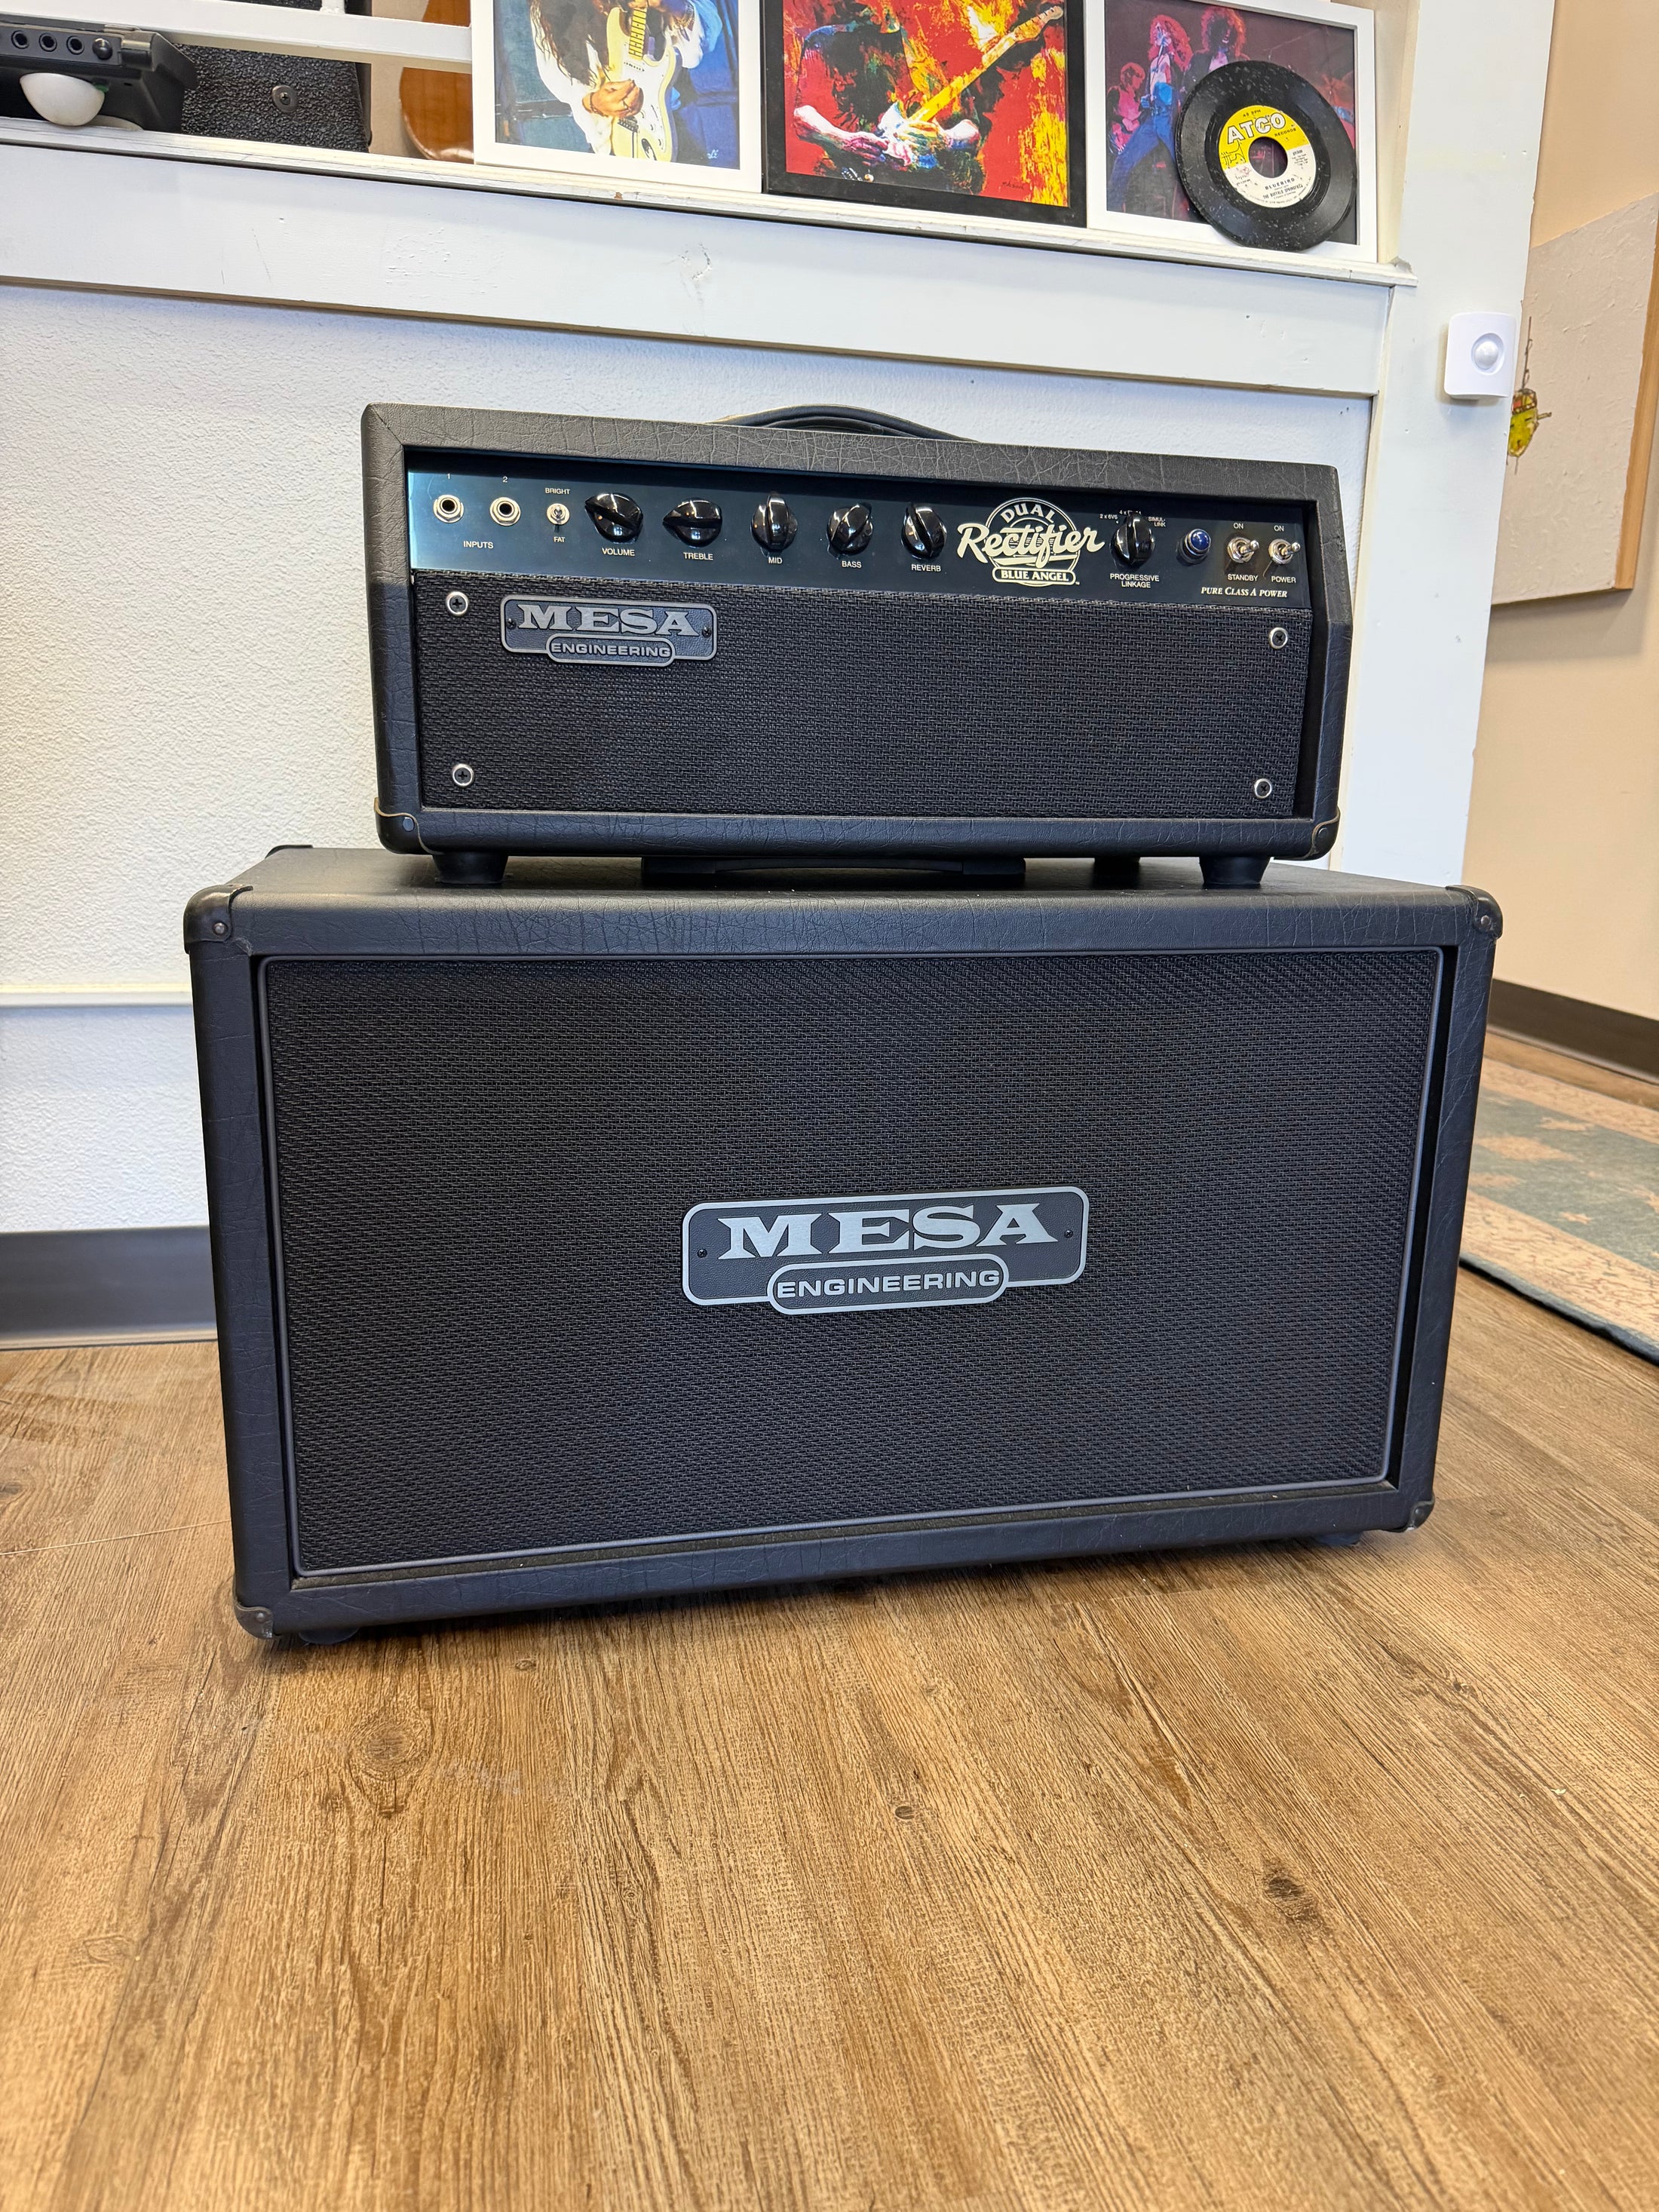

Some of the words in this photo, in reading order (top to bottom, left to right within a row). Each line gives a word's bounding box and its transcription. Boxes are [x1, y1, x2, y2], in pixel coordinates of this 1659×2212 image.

[1228, 112, 1286, 145] ATCO
[1274, 127, 1296, 137] RECORDS
[1265, 177, 1295, 190] BLUEBIRD
[1000, 503, 1056, 523] DUAL
[463, 541, 494, 549] INPUTS
[957, 523, 1105, 569] Rectifier
[602, 548, 635, 557] VOLUME
[682, 552, 713, 561] TREBLE
[768, 556, 783, 564] MID
[842, 560, 862, 569] BASS
[911, 563, 941, 572] REVERB
[1001, 569, 1029, 580] BLUE
[1032, 572, 1069, 581] ANGEL
[1110, 573, 1159, 582] PROGRESSIVE
[1271, 575, 1296, 584] POWER
[1201, 587, 1222, 595] PURE
[1225, 587, 1249, 596] CLASS
[1259, 589, 1287, 597] POWER
[517, 604, 699, 637] MESA
[550, 643, 670, 658] ENGINEERING
[716, 1203, 1058, 1260] MESA
[777, 1269, 1000, 1297] ENGINEERING
